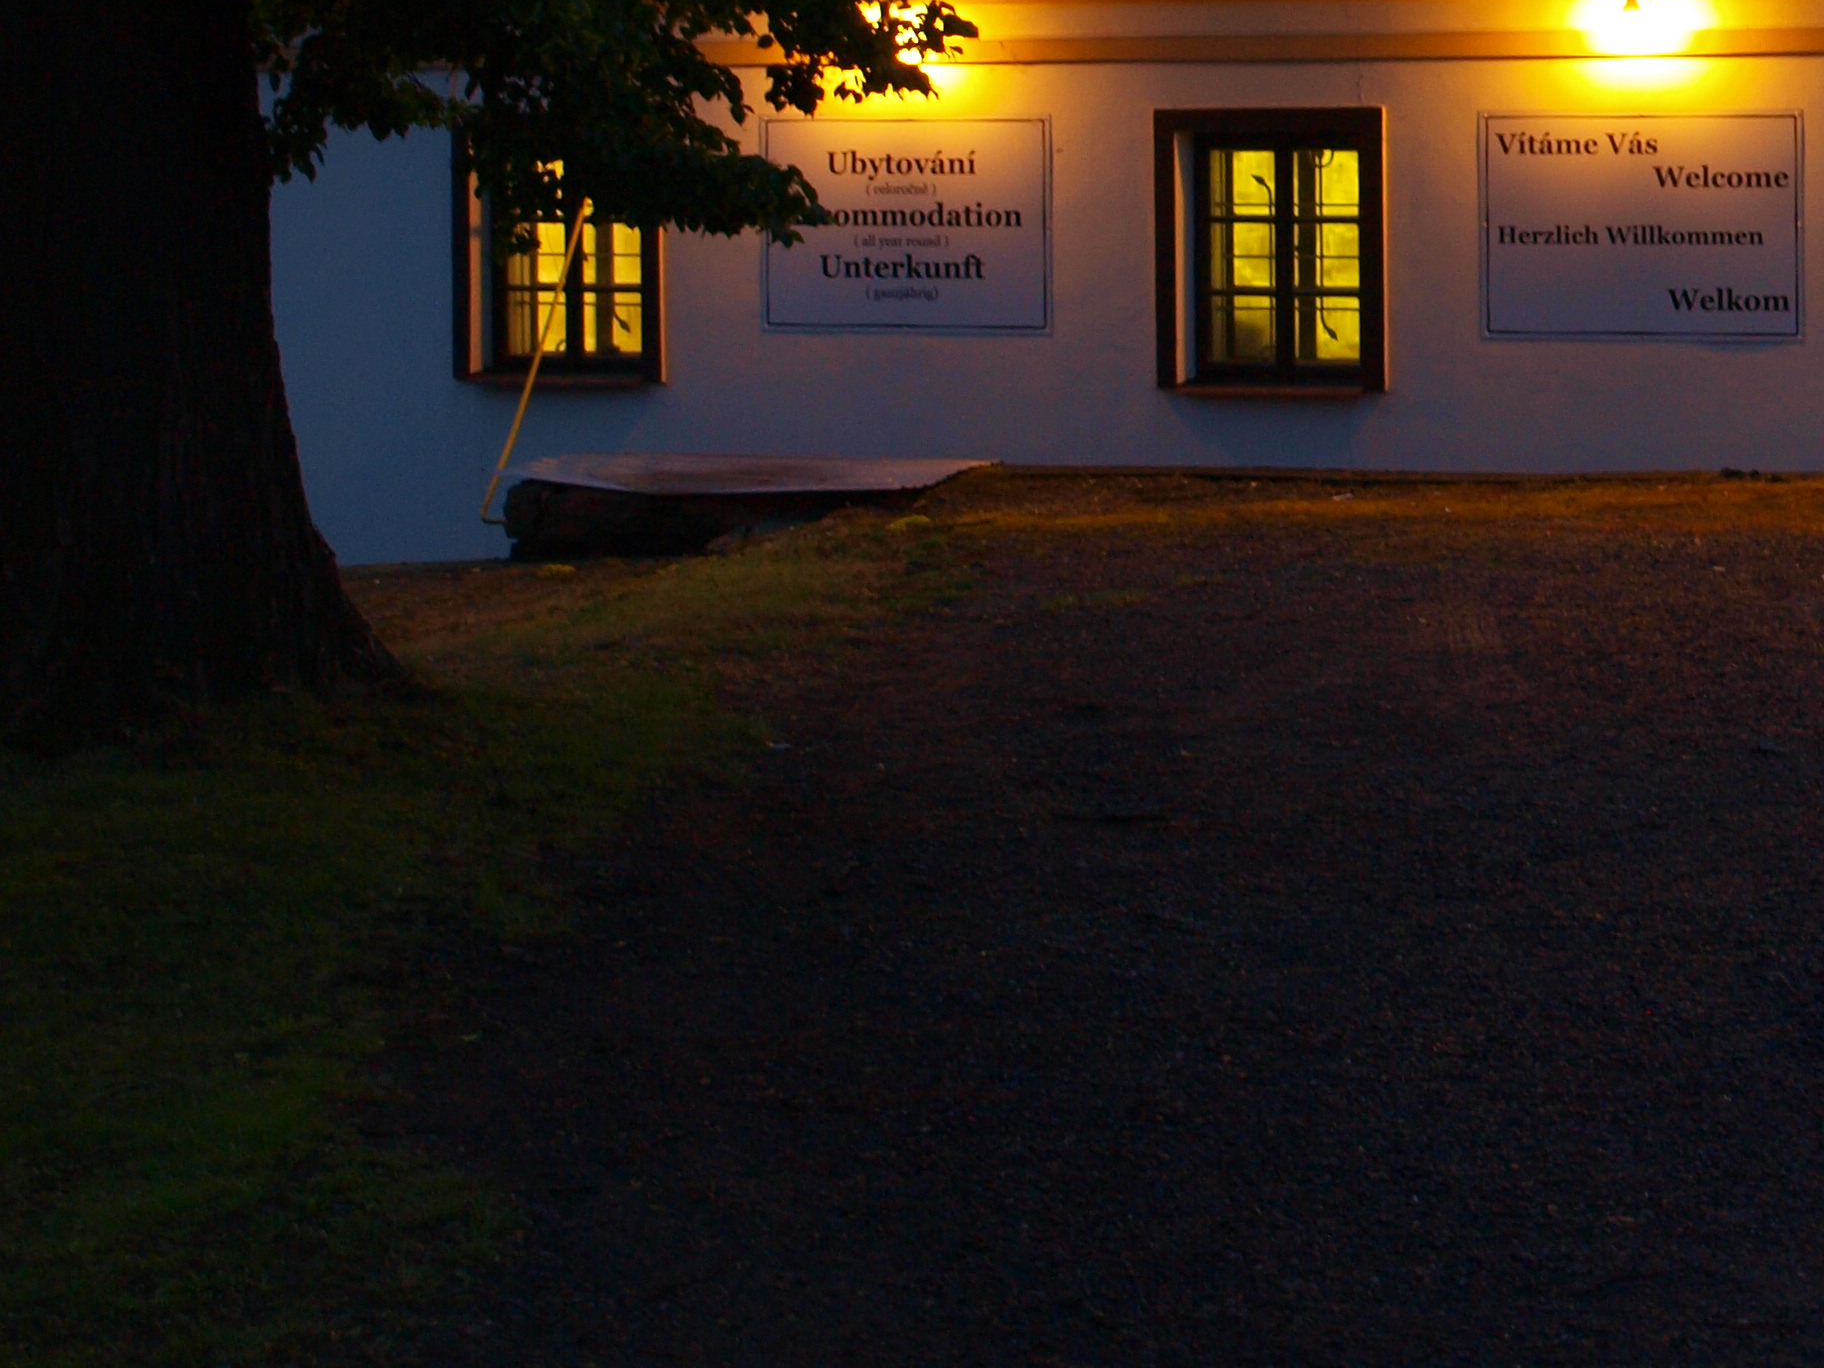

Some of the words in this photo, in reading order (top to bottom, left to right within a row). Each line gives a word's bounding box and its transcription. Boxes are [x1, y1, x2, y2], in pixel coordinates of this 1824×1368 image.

[1495, 132, 1598, 155] Vítáme
[1606, 132, 1658, 154] Vás
[827, 150, 976, 180] Ubytování
[1653, 165, 1789, 188] Welcome
[1497, 225, 1598, 245] Herzlich
[1605, 225, 1763, 246] Willkommen
[820, 254, 985, 280] Unterkunft
[1668, 288, 1790, 313] Welkom
